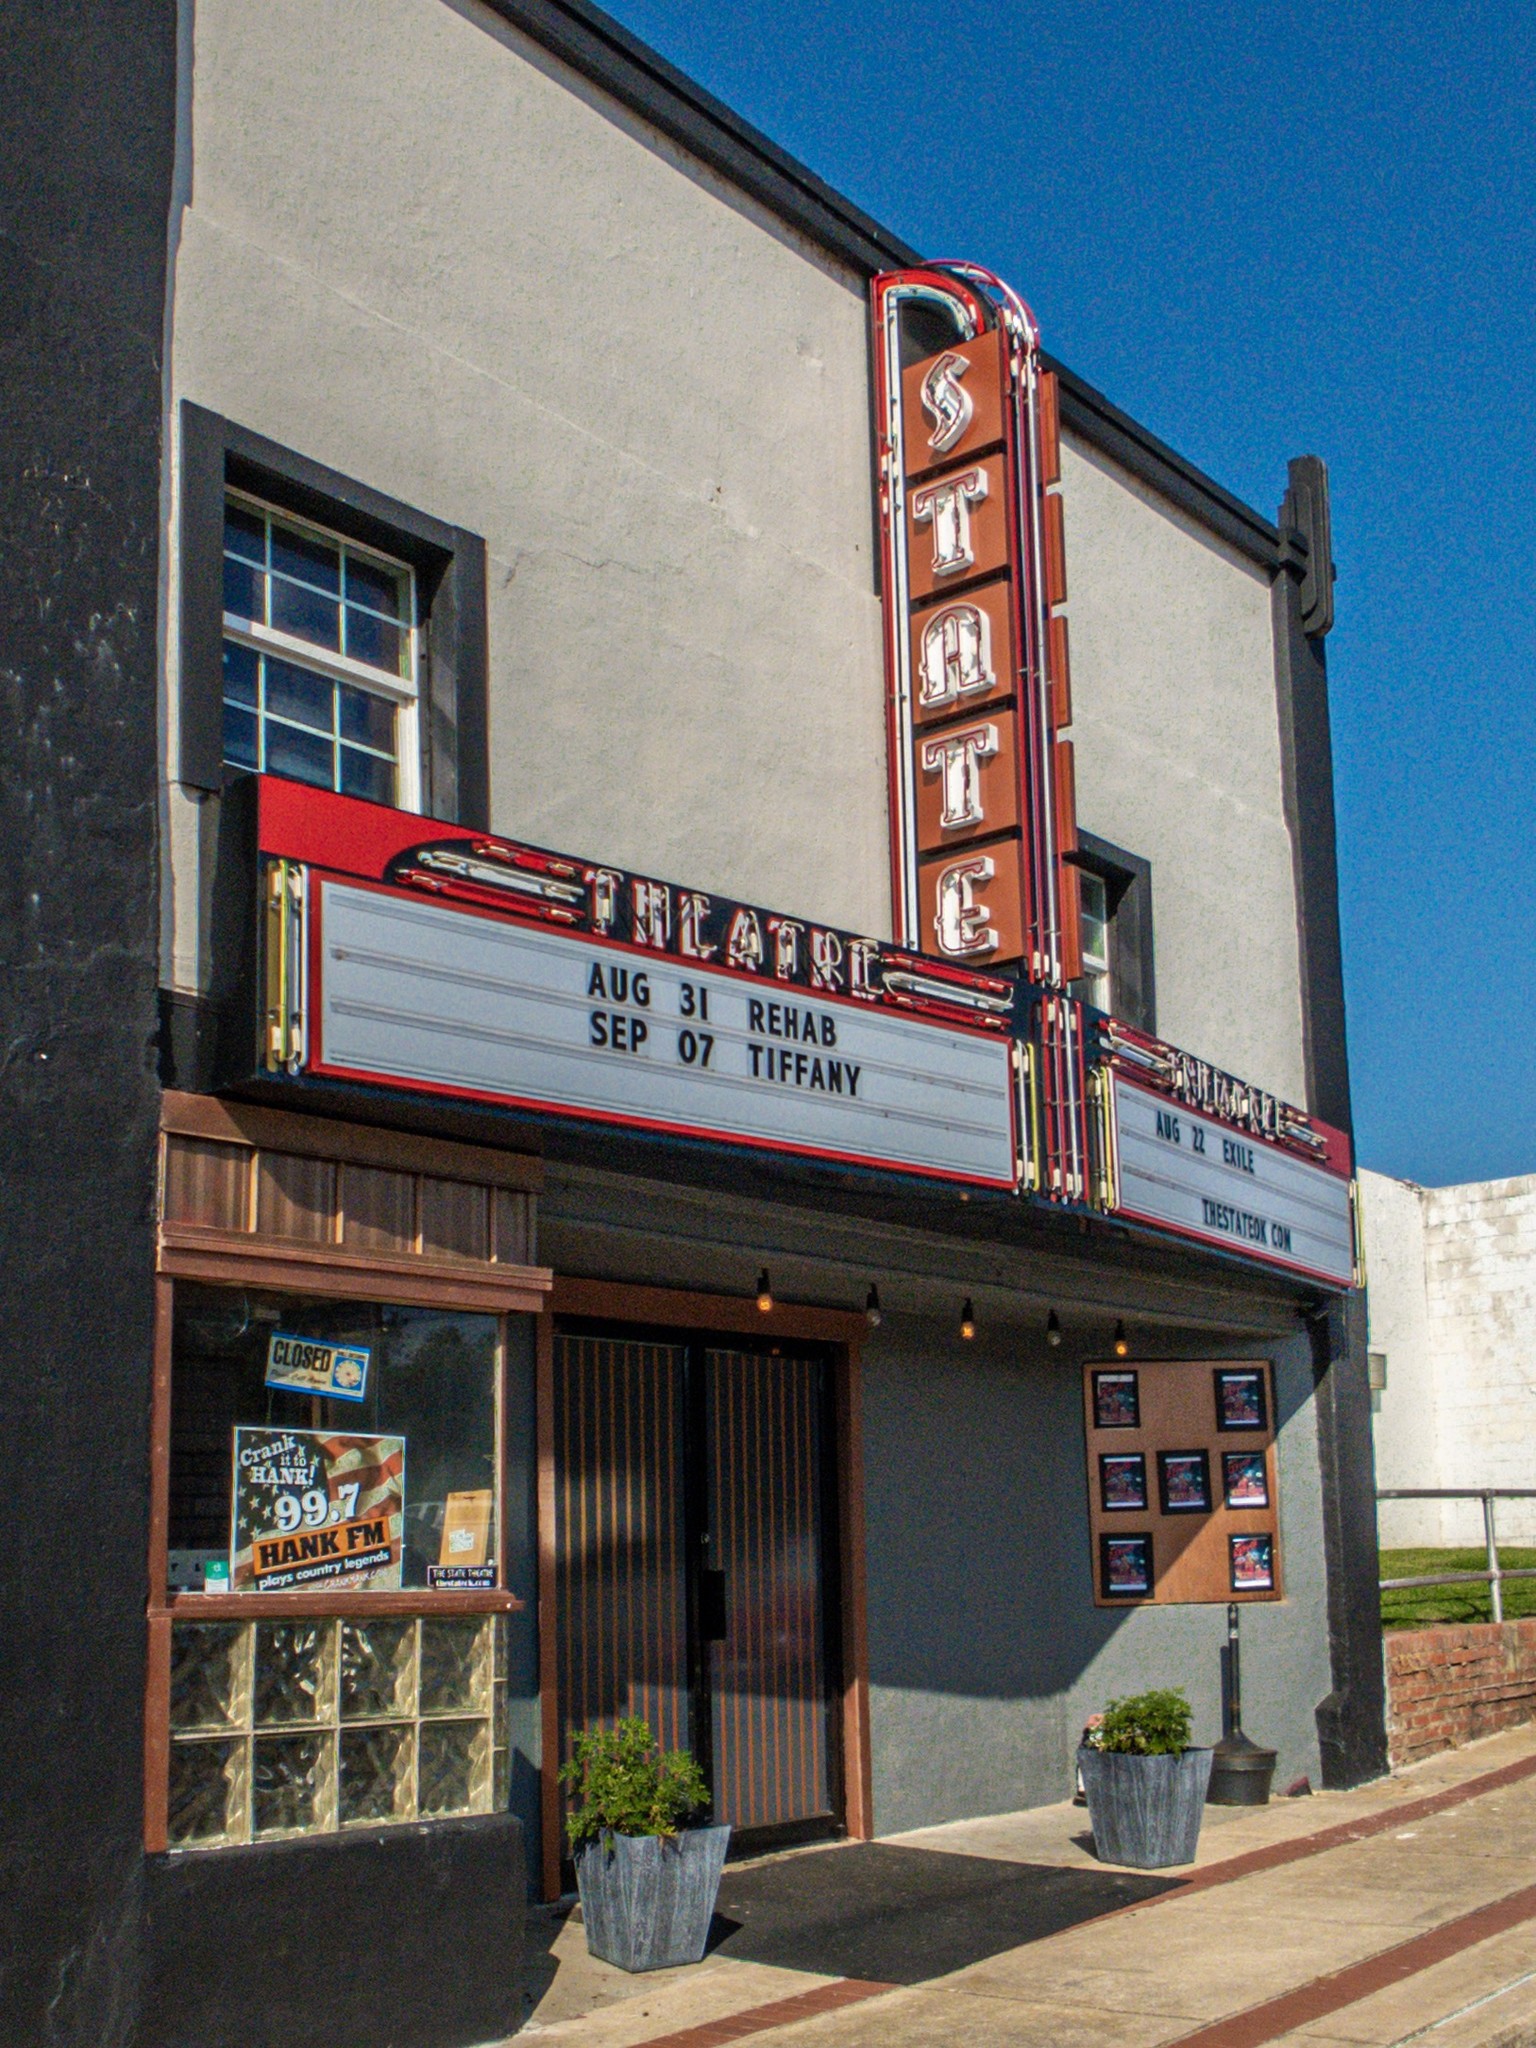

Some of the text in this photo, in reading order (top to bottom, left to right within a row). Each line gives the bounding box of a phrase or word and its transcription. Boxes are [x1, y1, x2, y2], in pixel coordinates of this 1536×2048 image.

[912, 352, 999, 958] STATE
[583, 867, 884, 1001] THEATRE
[588, 962, 838, 1048] AUG 31 REHAB
[590, 1011, 861, 1097] SEP 07 TIFFANY
[1156, 1110, 1255, 1174] AUG 22 EXILE
[1271, 1223, 1292, 1254] COM
[273, 1340, 332, 1373] CLOSED
[239, 1433, 297, 1467] Crank
[280, 1452, 307, 1468] it to
[250, 1464, 316, 1486] HANK!
[274, 1482, 360, 1532] 99.7
[258, 1521, 386, 1570] HANK FM
[258, 1549, 390, 1591] plays country legends
